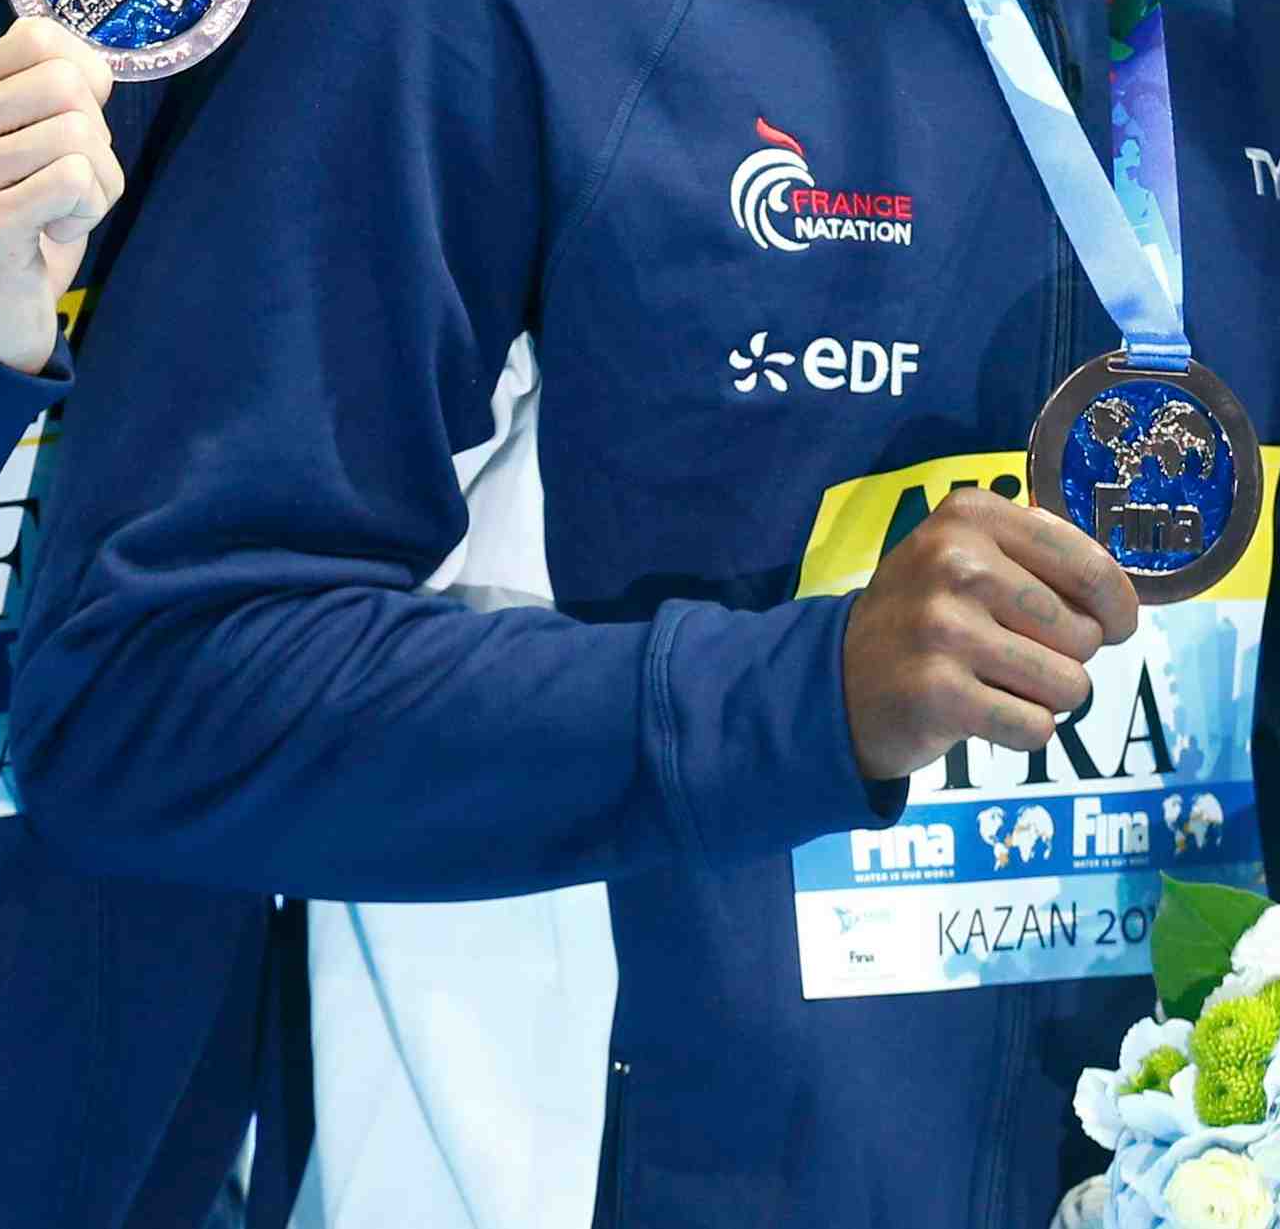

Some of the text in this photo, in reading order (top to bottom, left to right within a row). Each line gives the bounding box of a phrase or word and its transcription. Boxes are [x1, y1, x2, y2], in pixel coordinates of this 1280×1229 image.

[792, 189, 913, 219] FRANCE
[794, 216, 912, 247] NATATION
[802, 337, 920, 397] eDF
[1072, 796, 1150, 858] Fina
[937, 901, 1156, 957] KAZAN 20
